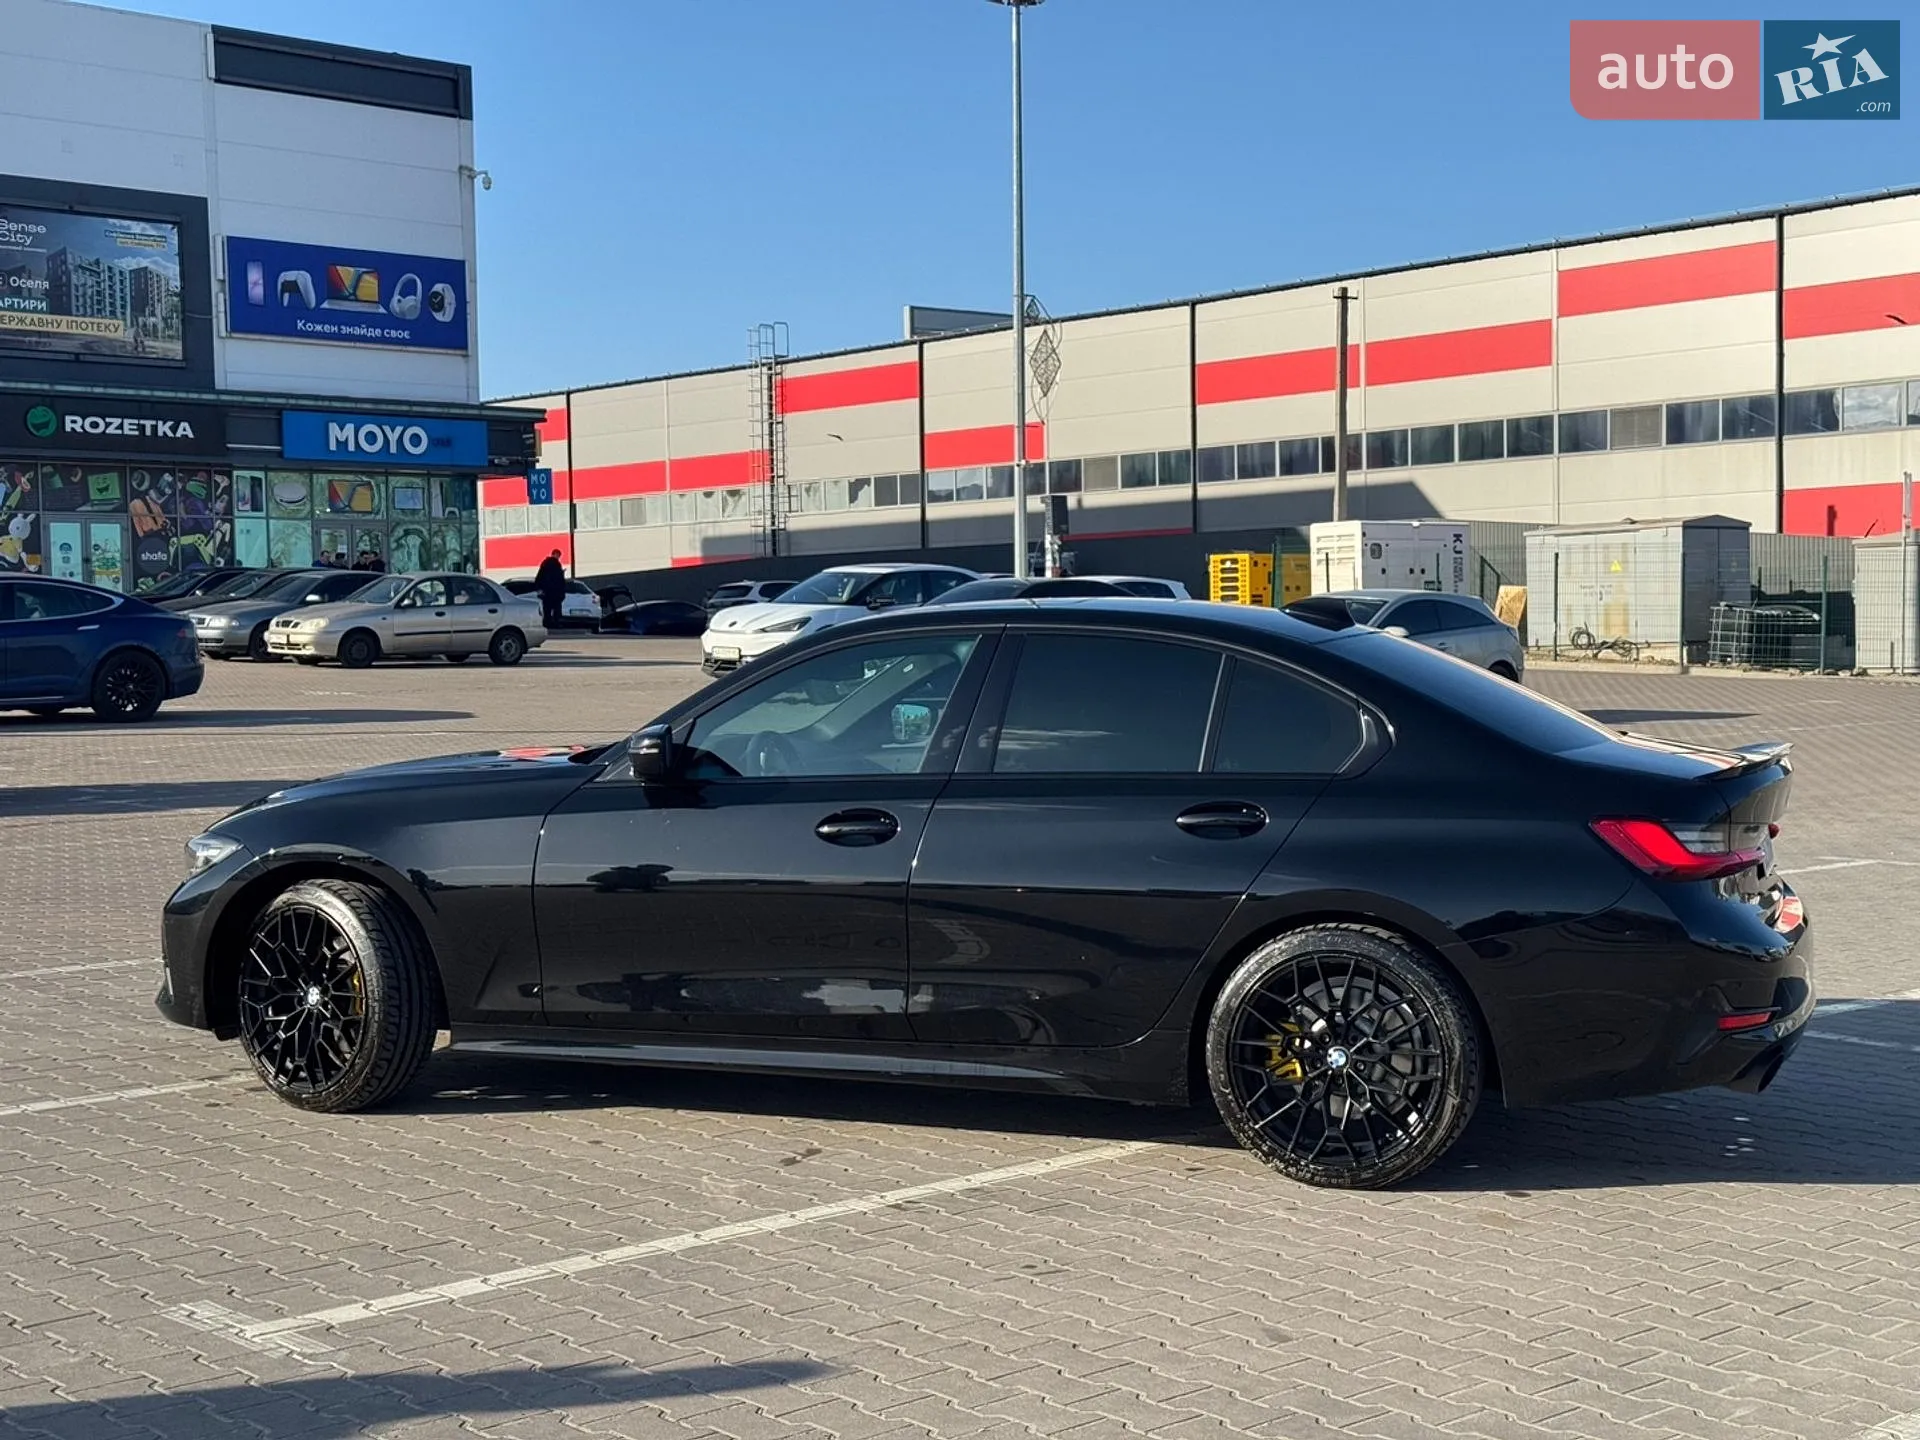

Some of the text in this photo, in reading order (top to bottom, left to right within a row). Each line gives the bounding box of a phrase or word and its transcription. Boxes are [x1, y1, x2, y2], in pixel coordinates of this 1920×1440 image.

[0, 219, 47, 234] Sense
[0, 230, 33, 246] City
[66, 320, 120, 334] ІПОТЕКУ
[297, 319, 411, 340] Кожен знайде своє
[64, 415, 195, 439] ROZETKA
[328, 421, 429, 455] MOYO
[141, 551, 168, 561] shafa
